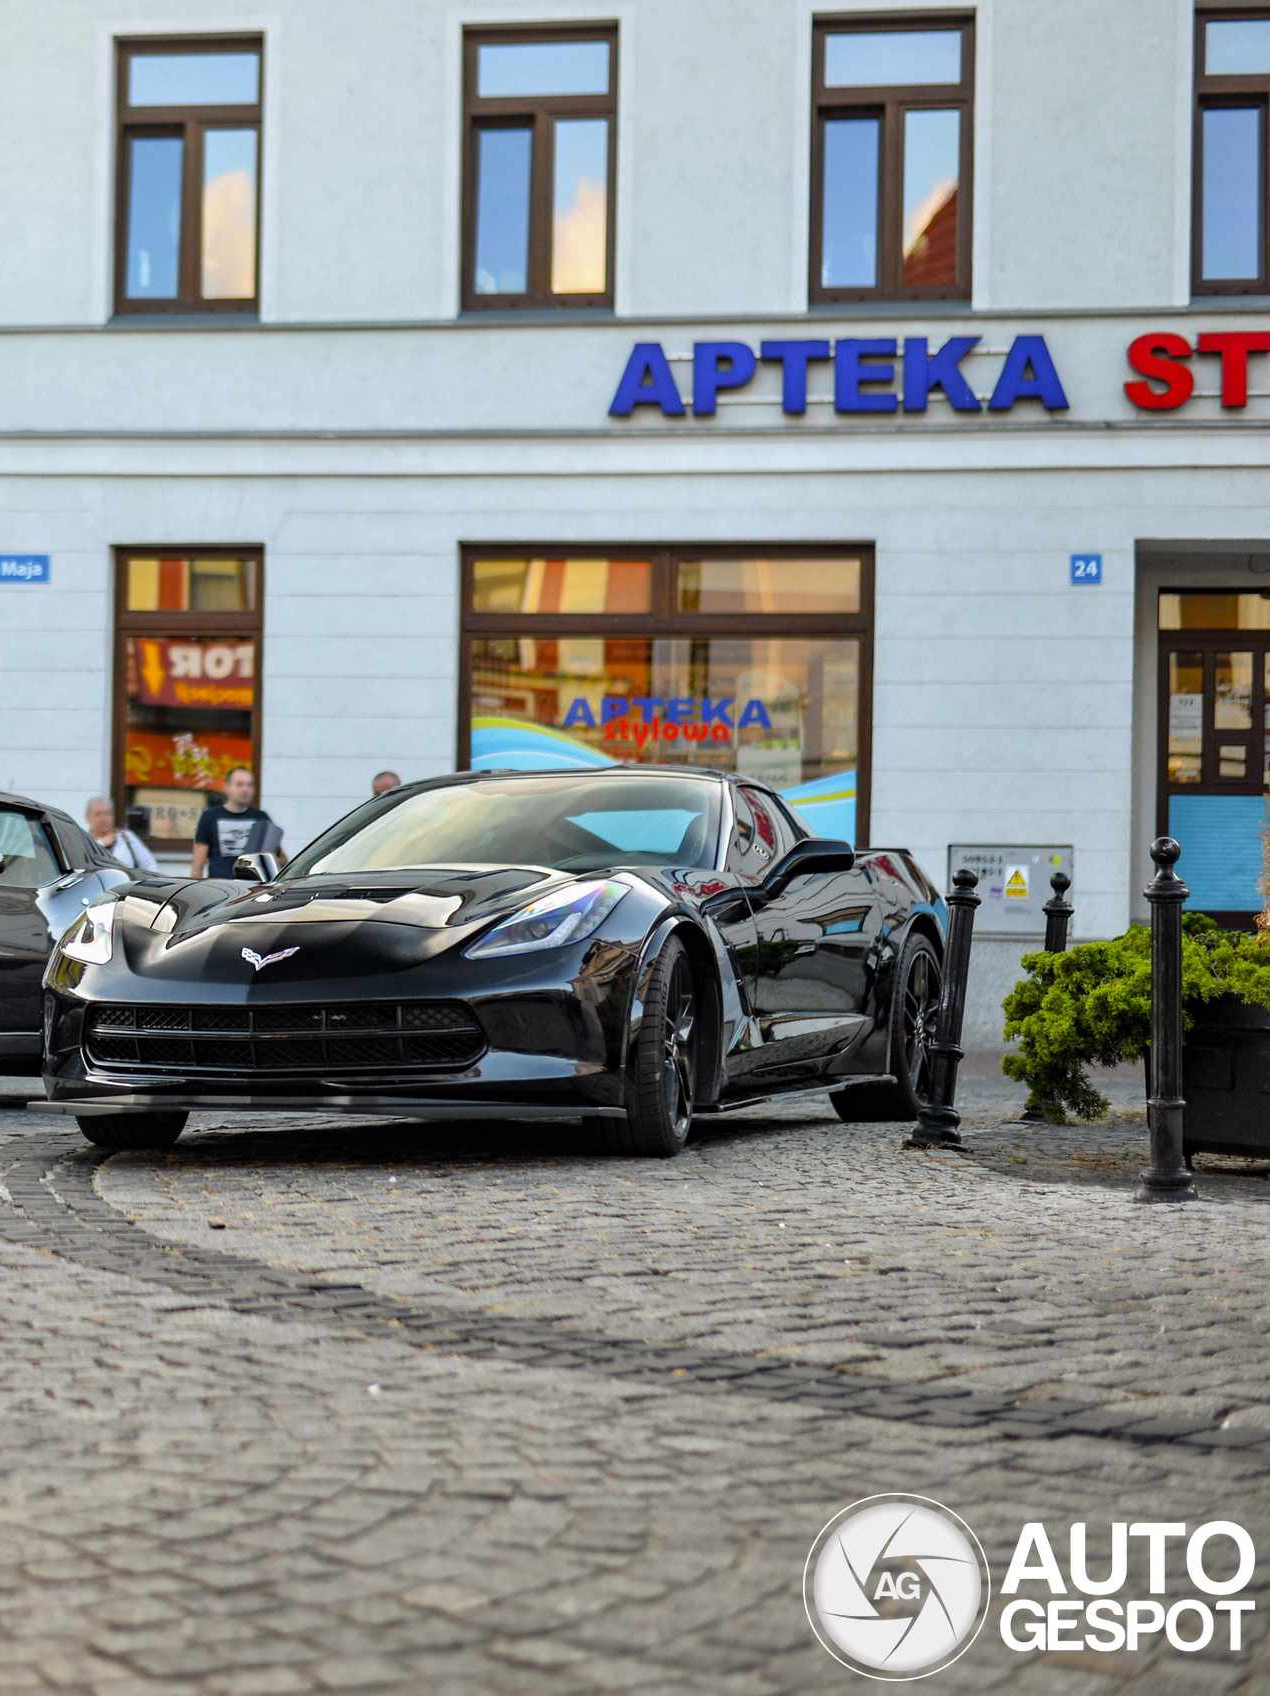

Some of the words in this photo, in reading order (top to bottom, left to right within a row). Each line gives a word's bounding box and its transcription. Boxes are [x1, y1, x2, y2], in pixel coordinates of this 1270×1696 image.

[608, 335, 1069, 416] APTEKA
[1, 562, 43, 580] Maja
[1074, 560, 1098, 577] 24
[562, 697, 772, 729] APTEKA
[603, 716, 730, 748] stylowa
